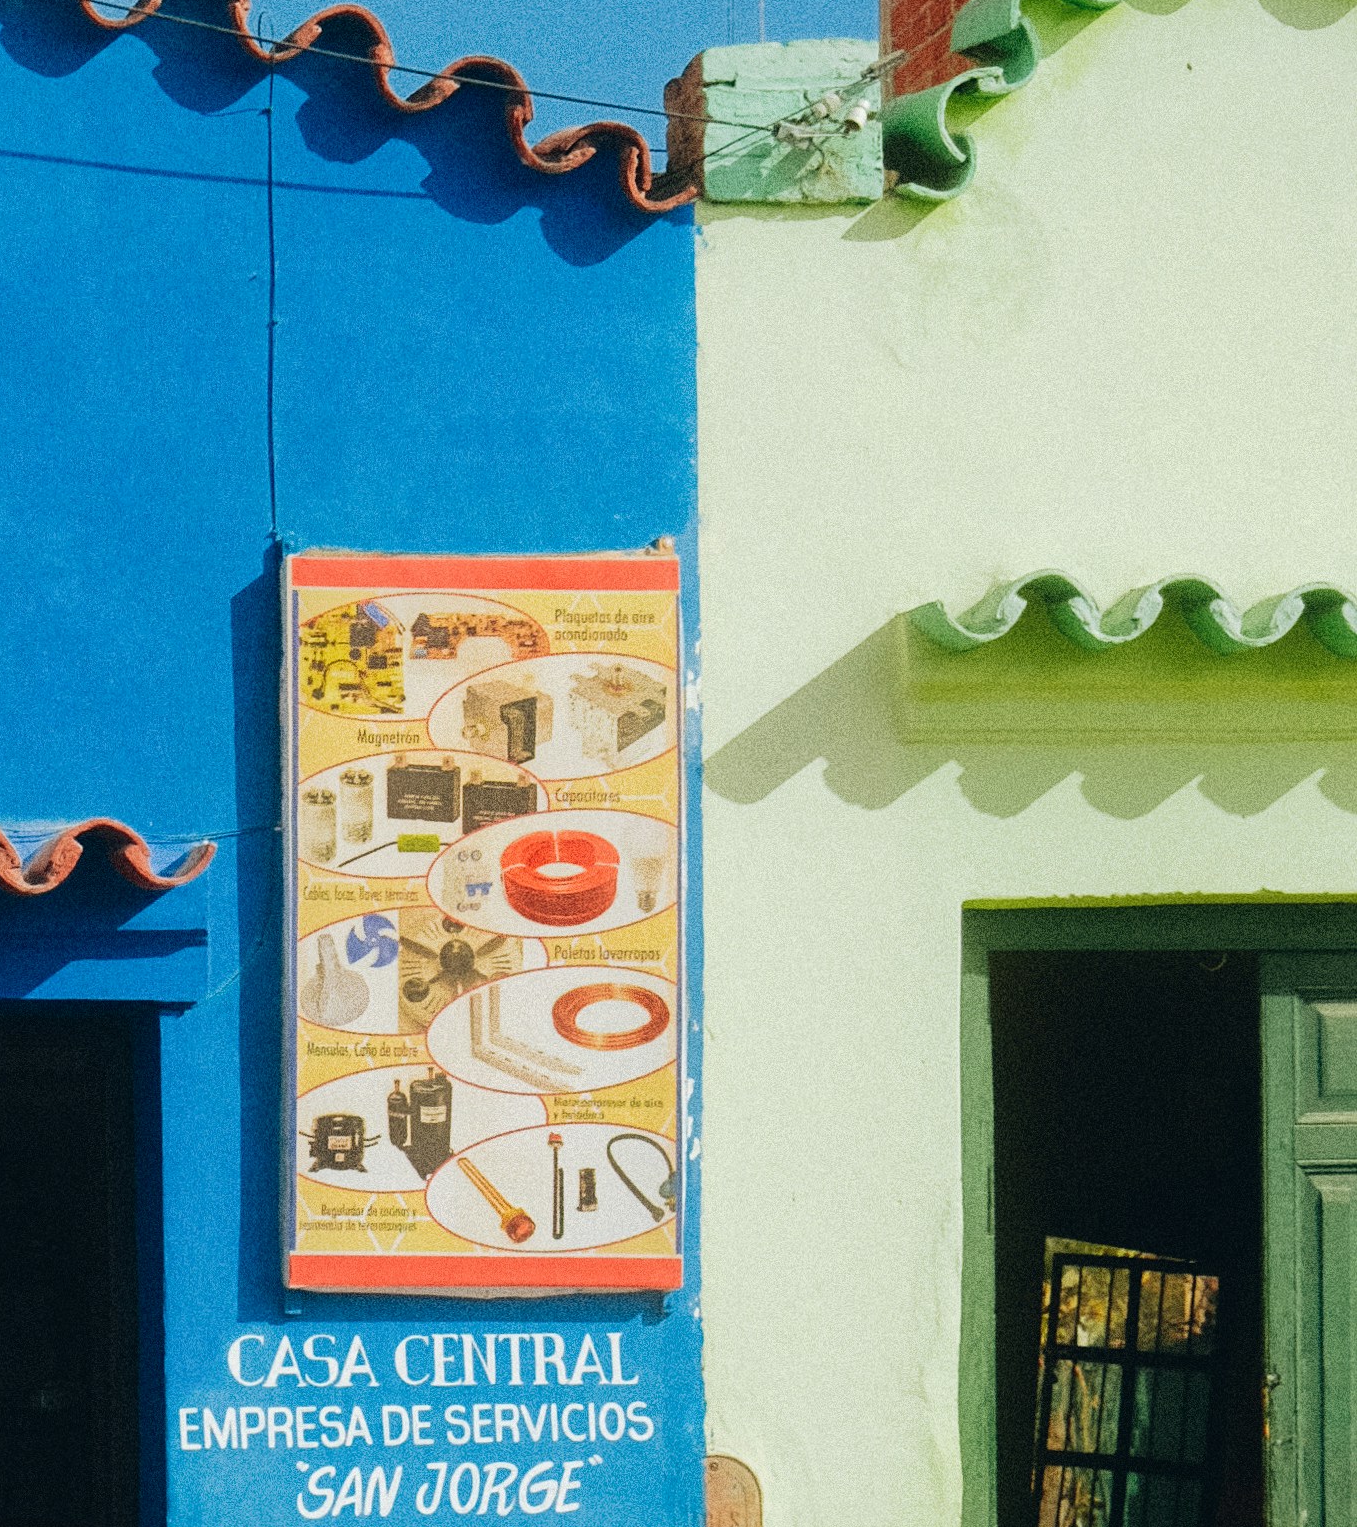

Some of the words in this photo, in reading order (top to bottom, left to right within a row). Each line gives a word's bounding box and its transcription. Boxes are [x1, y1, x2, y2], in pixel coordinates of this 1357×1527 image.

[615, 609, 628, 624] de
[632, 610, 655, 624] aire
[357, 727, 420, 745] Magnetrón
[554, 945, 595, 961] Paletas
[598, 945, 661, 963] lavarropas
[227, 1333, 380, 1388] CASA
[394, 1332, 639, 1388] CENTRAL
[180, 1405, 373, 1451] EMPRESA
[382, 1404, 434, 1447] DE
[444, 1401, 655, 1446] SERVICIOS
